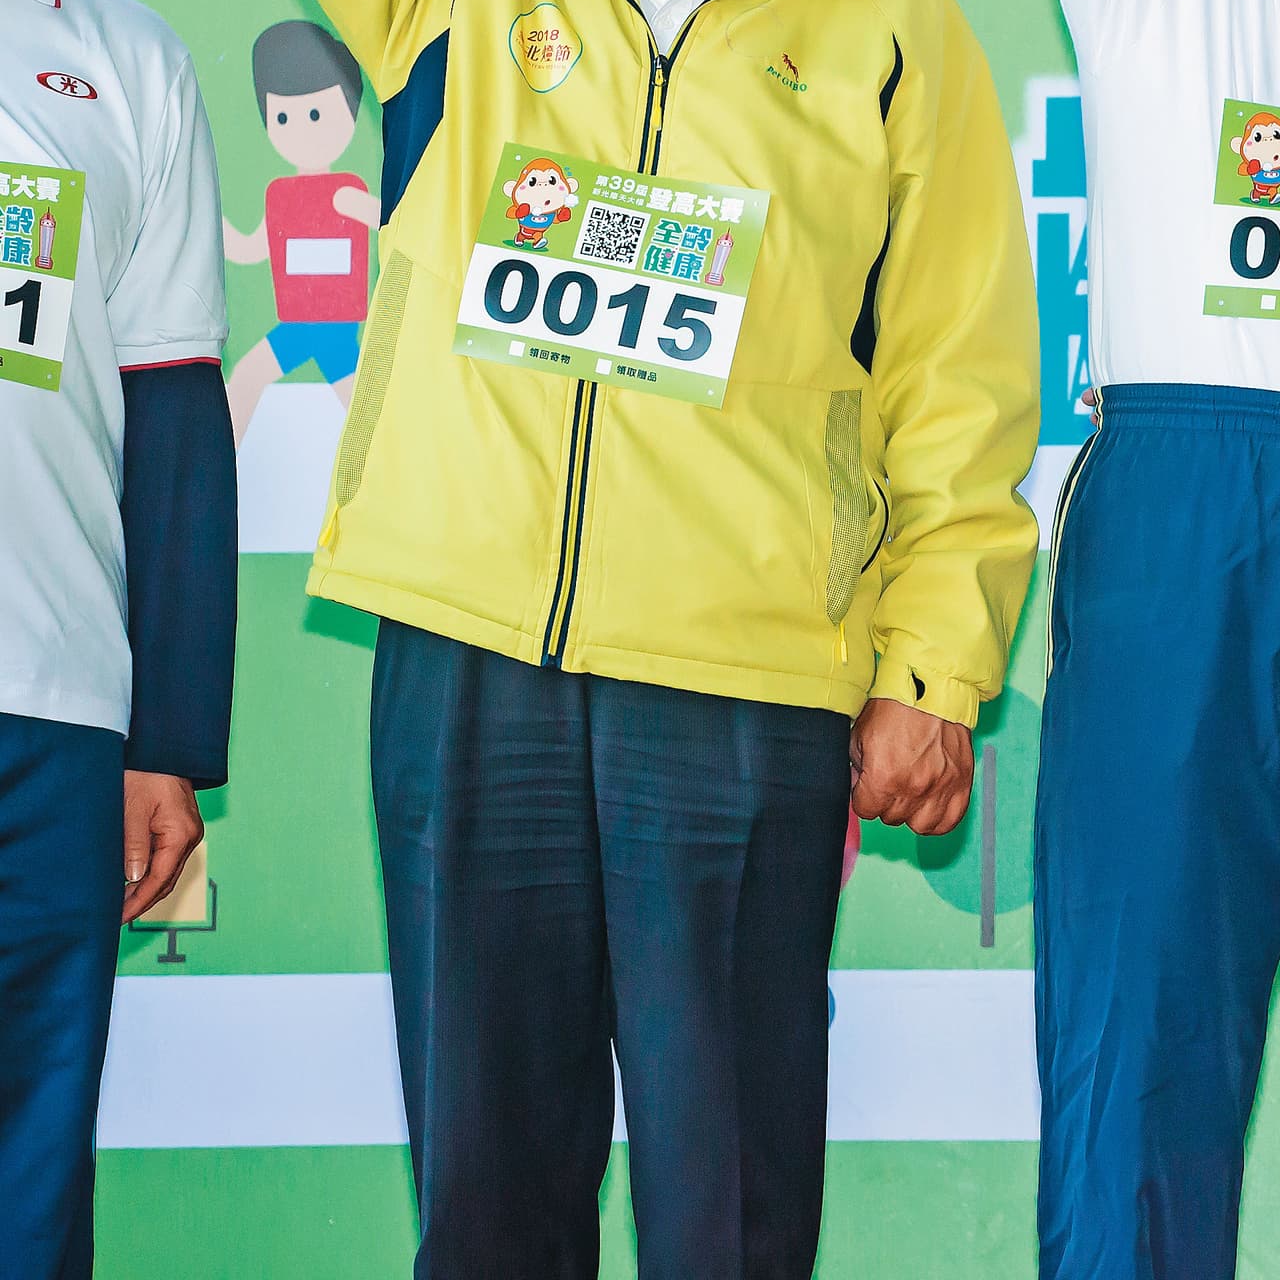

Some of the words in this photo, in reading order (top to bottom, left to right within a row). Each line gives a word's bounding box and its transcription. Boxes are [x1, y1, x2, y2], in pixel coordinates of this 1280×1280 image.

[527, 29, 560, 42] 2018
[0, 205, 35, 235] 齡
[646, 186, 745, 224] 登高大賽
[0, 235, 32, 266] 康
[652, 219, 713, 252] 全齡
[642, 244, 704, 282] 健康
[4, 279, 42, 346] 1
[483, 258, 717, 361] 0015
